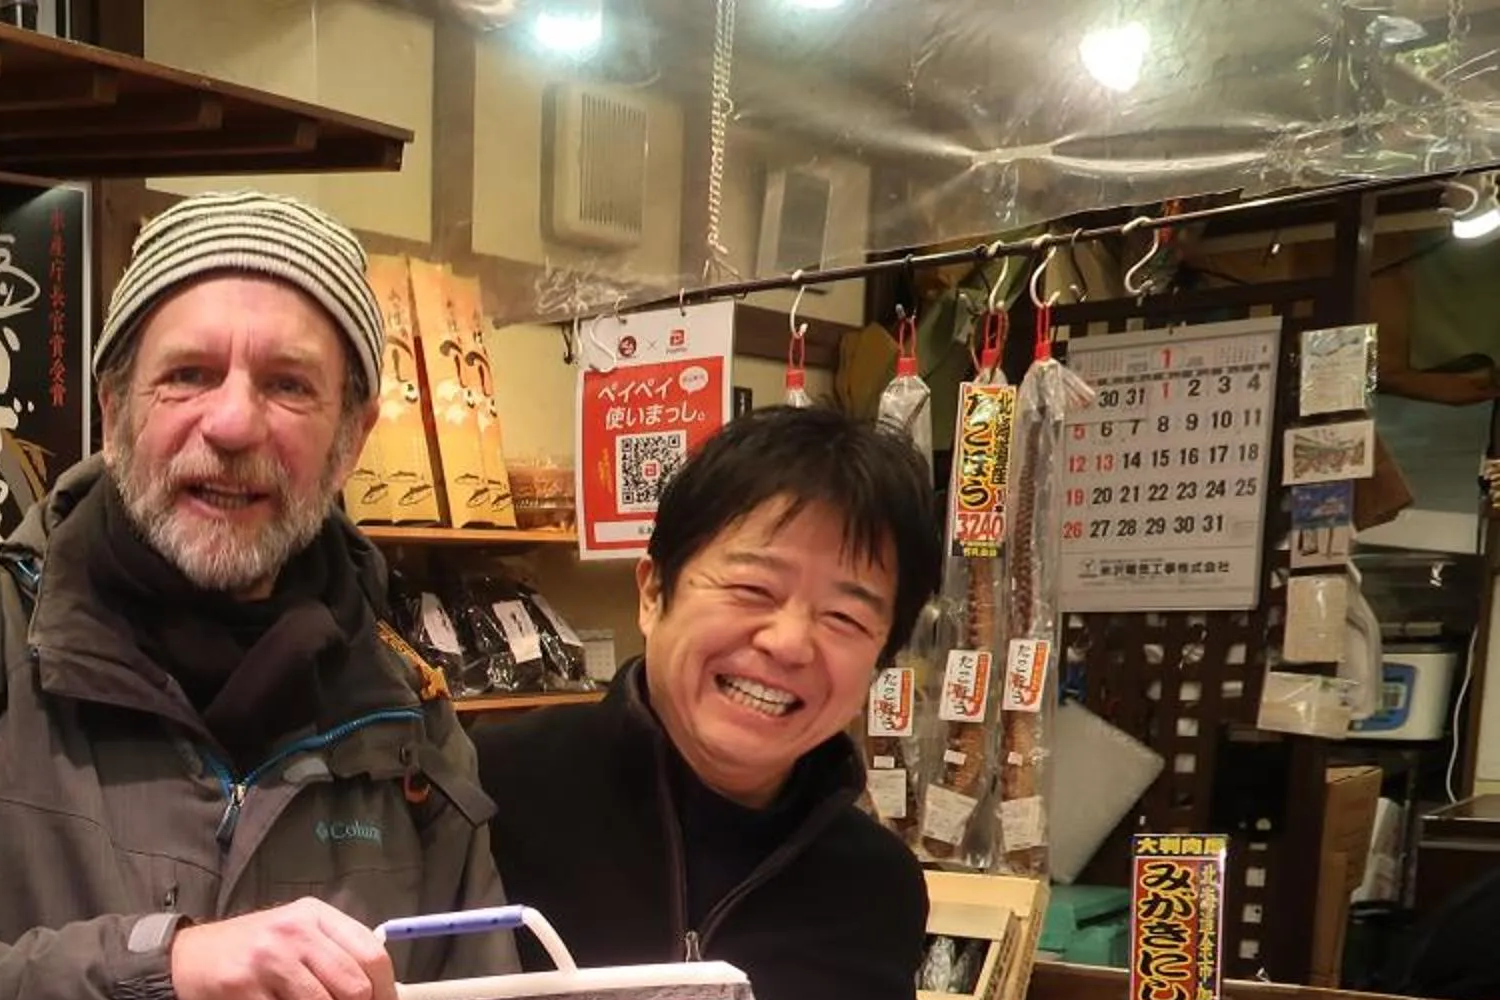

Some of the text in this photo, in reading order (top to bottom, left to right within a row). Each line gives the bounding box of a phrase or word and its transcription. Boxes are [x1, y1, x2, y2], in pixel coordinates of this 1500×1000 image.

[598, 377, 673, 402] ペイペイ
[1099, 375, 1260, 407] 30 31 1 2 3 4
[606, 402, 706, 430] 使いまっし。
[1101, 421, 1113, 437] 6
[1131, 420, 1140, 434] 7
[1157, 416, 1169, 432] 8
[1186, 414, 1197, 430] 9
[1212, 411, 1232, 428] 10
[1244, 409, 1261, 426] 11
[1070, 444, 1258, 472] 12 13 14 15 16 17 18
[1067, 479, 1257, 505] 19 20 21 22 23 24 25
[1063, 515, 1223, 538] 26 27 28 29 30 31
